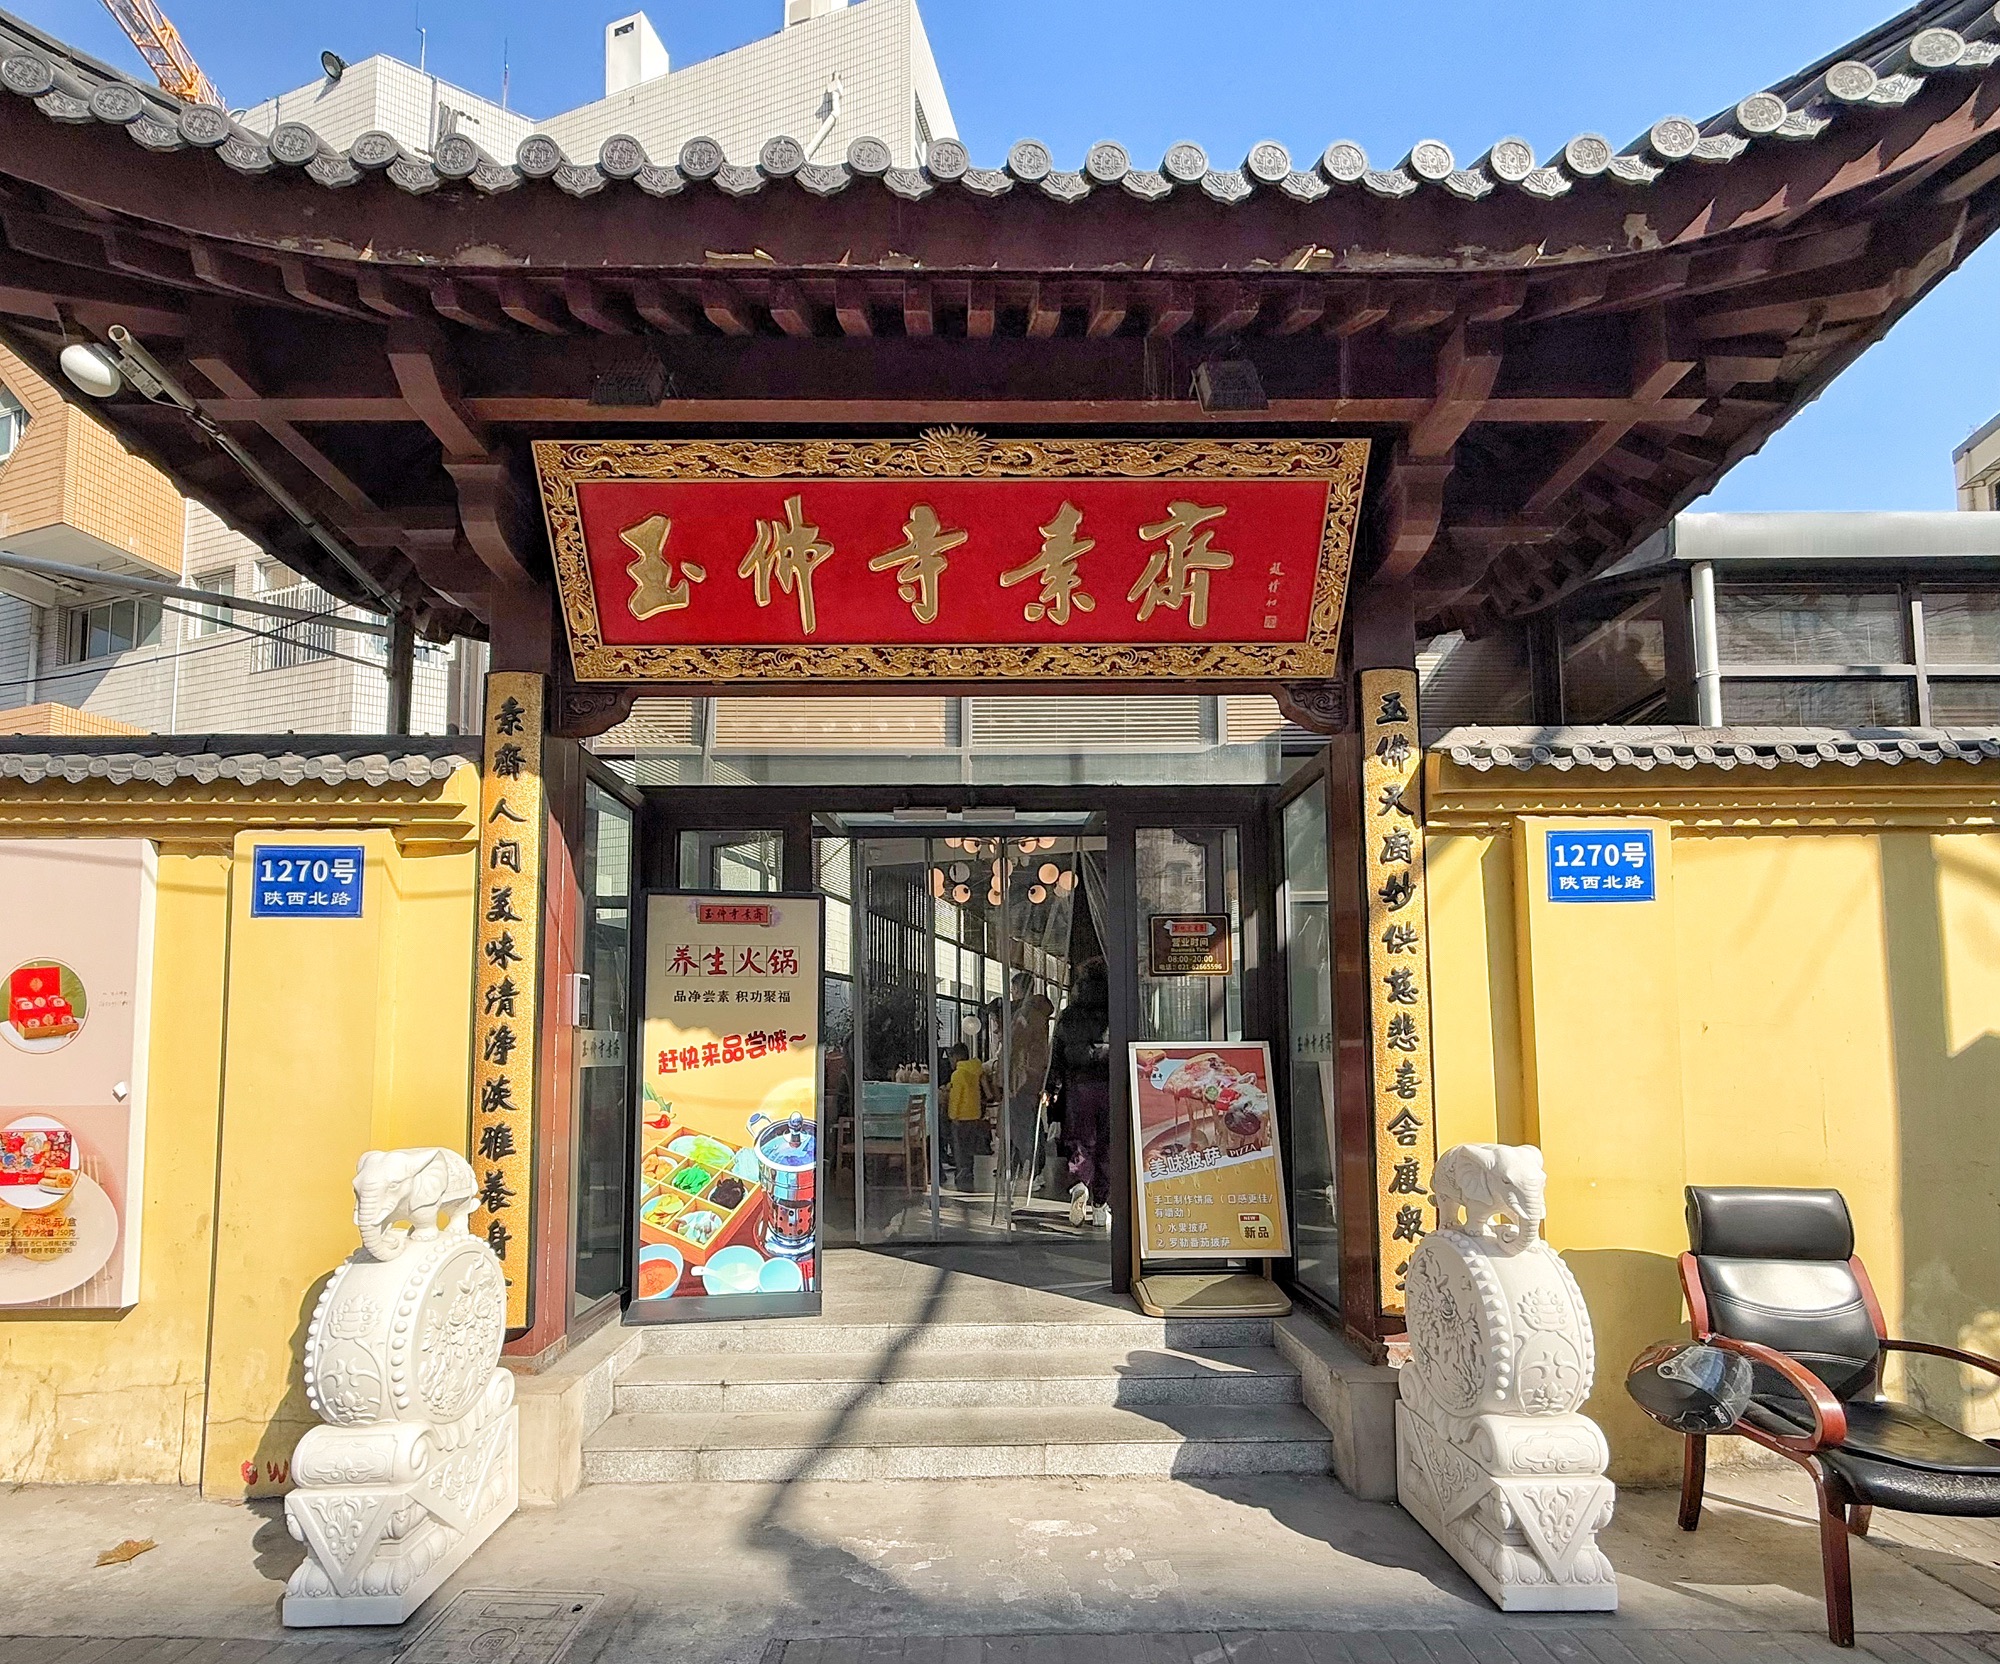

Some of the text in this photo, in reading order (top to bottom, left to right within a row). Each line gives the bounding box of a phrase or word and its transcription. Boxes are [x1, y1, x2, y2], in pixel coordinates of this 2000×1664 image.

[1554, 842, 1647, 868] 1270号
[260, 858, 357, 885] 1270号
[1558, 874, 1645, 890] 陕西北路
[263, 890, 352, 906] 陕西北路
[1171, 937, 1209, 947] 营业时间
[667, 944, 799, 976] 养生火锅
[673, 989, 791, 1003] 品净尝素 积功聚福
[1229, 1143, 1257, 1157] PIZZA
[1149, 1146, 1221, 1178] 美味披萨
[1168, 1222, 1208, 1233] 水果披萨
[1244, 1226, 1269, 1239] 新品
